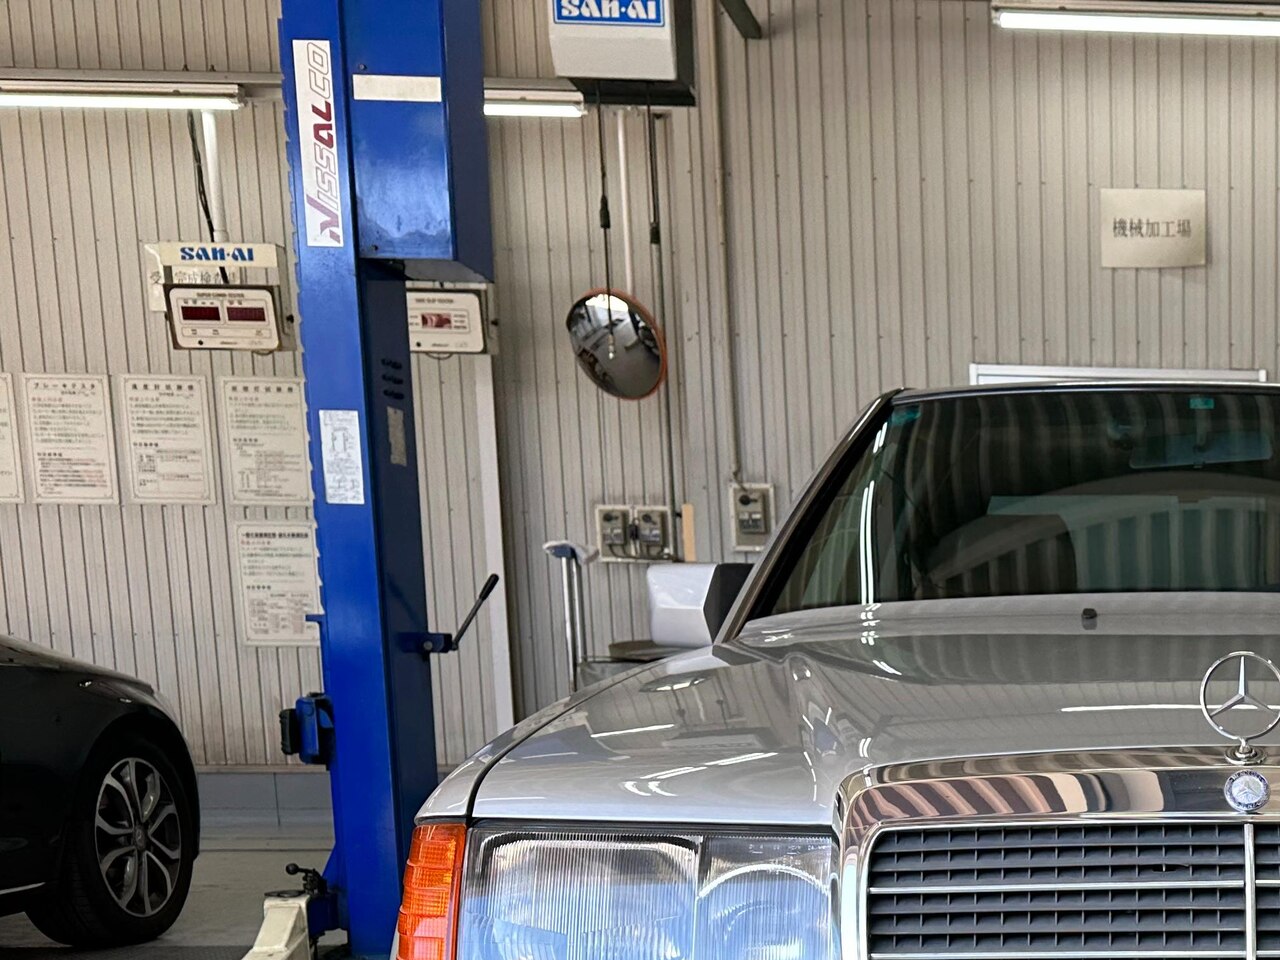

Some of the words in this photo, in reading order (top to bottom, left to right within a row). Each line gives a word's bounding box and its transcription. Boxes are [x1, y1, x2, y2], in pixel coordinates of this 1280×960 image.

[1113, 218, 1191, 238] 機械加工場
